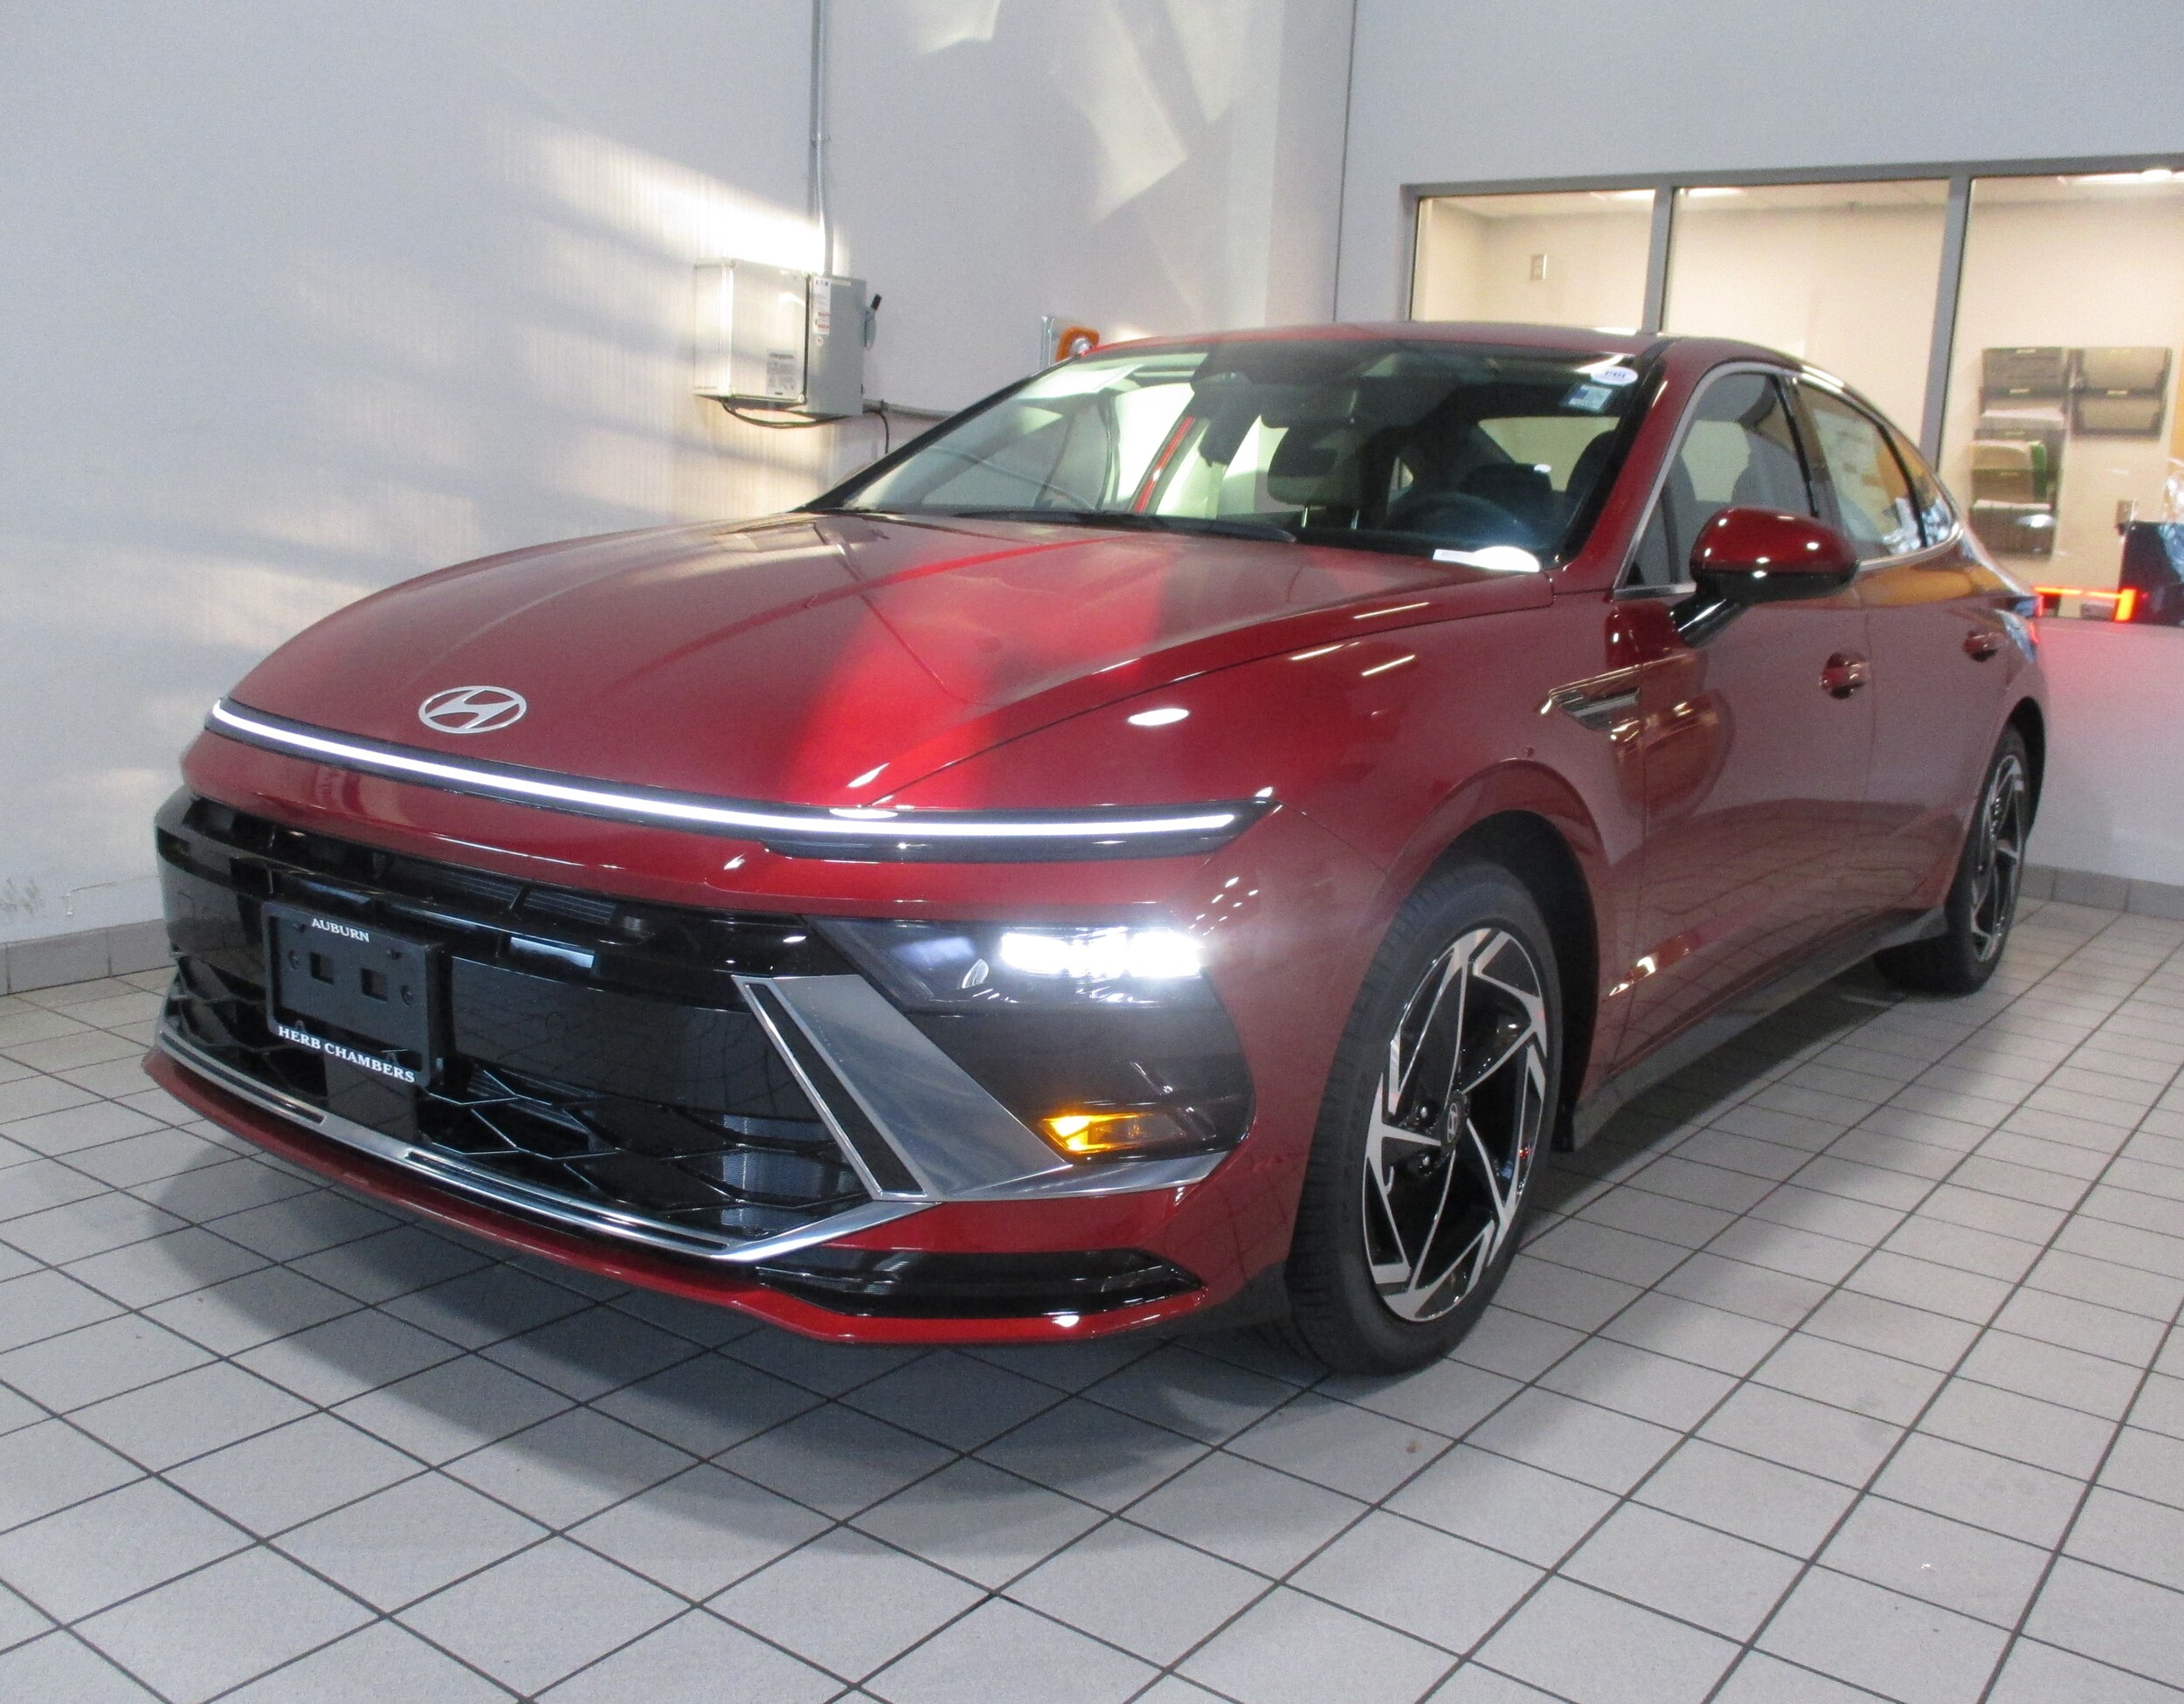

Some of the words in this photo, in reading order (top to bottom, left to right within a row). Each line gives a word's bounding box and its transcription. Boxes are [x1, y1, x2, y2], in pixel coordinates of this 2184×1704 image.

[311, 918, 370, 943] AUBURN
[279, 1026, 321, 1050] HERB
[324, 1042, 416, 1083] CHAMBERS
